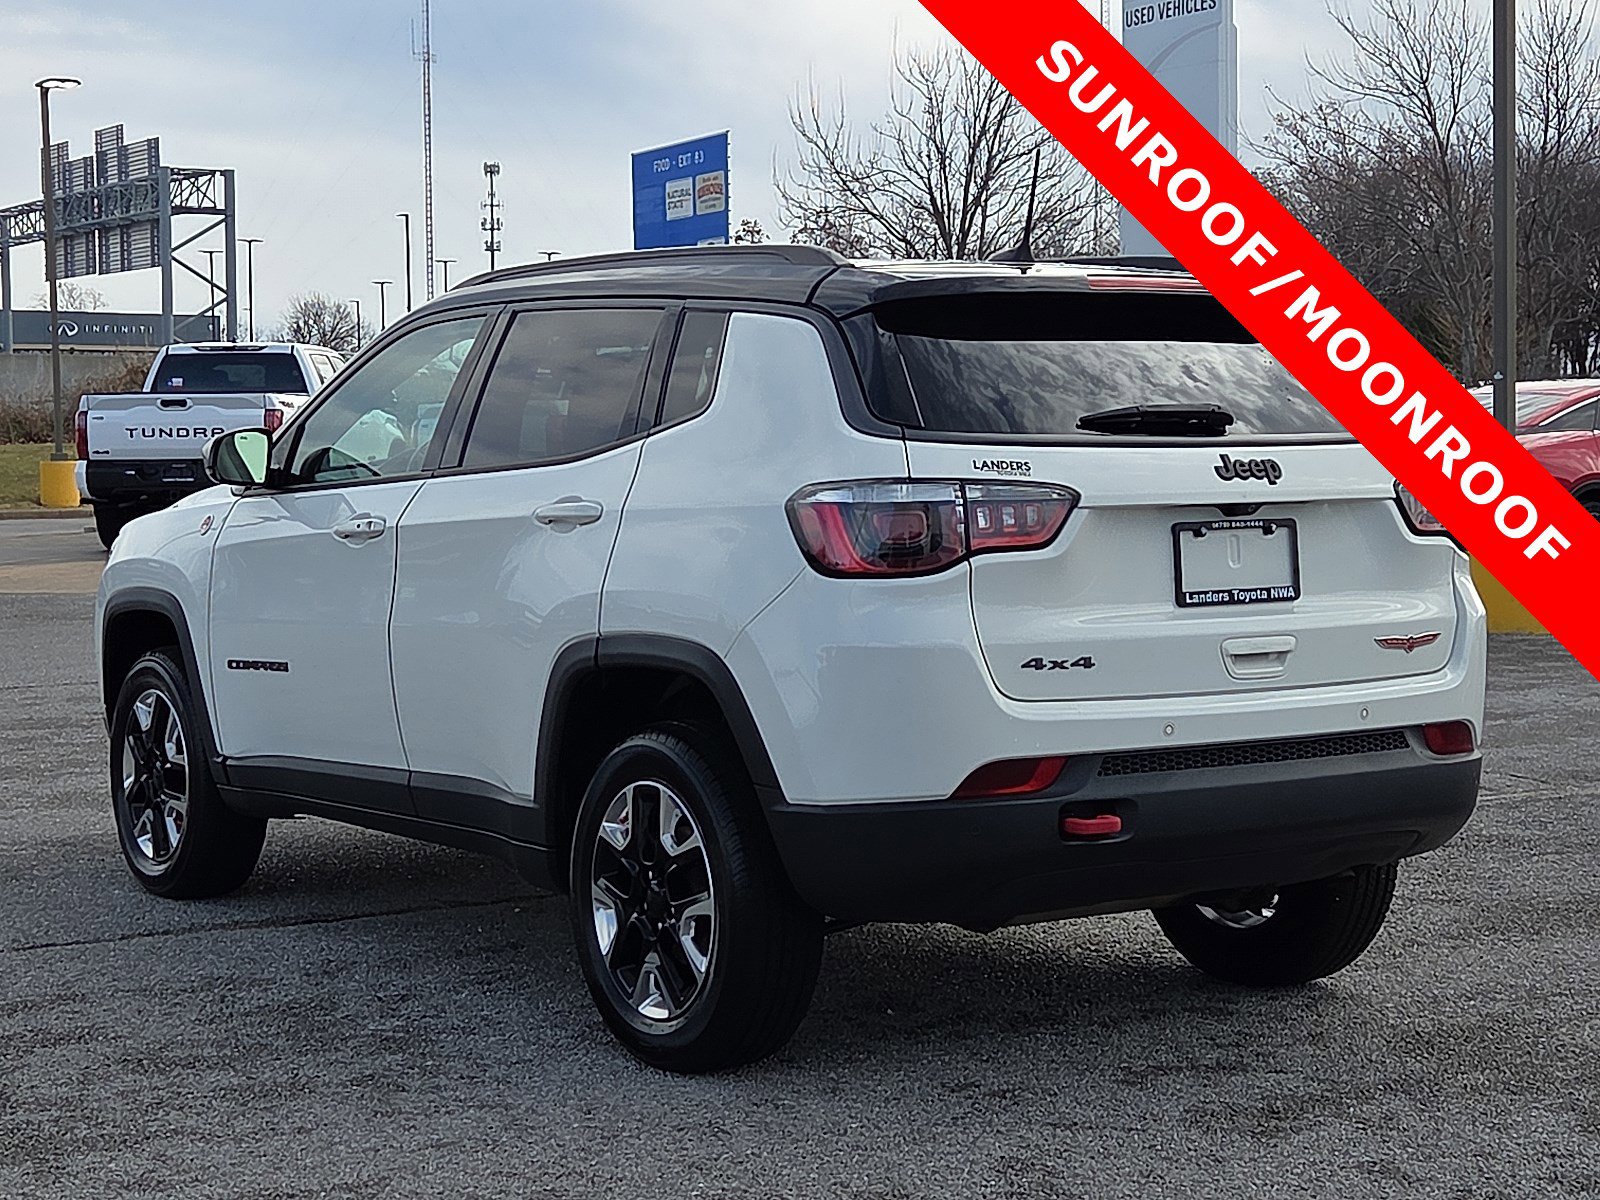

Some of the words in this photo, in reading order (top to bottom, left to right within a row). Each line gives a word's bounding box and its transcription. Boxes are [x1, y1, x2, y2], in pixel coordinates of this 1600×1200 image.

[1125, 5, 1155, 28] USED
[1158, 0, 1217, 20] VEHICLES
[653, 157, 671, 173] FOOD
[84, 324, 153, 334] INFINITI
[972, 459, 1032, 471] LANDERS
[1213, 453, 1283, 486] Jeep
[1185, 591, 1230, 604] Landers
[1231, 588, 1268, 603] Toyota
[1270, 586, 1296, 599] NWA
[1020, 656, 1096, 671] 4x4
